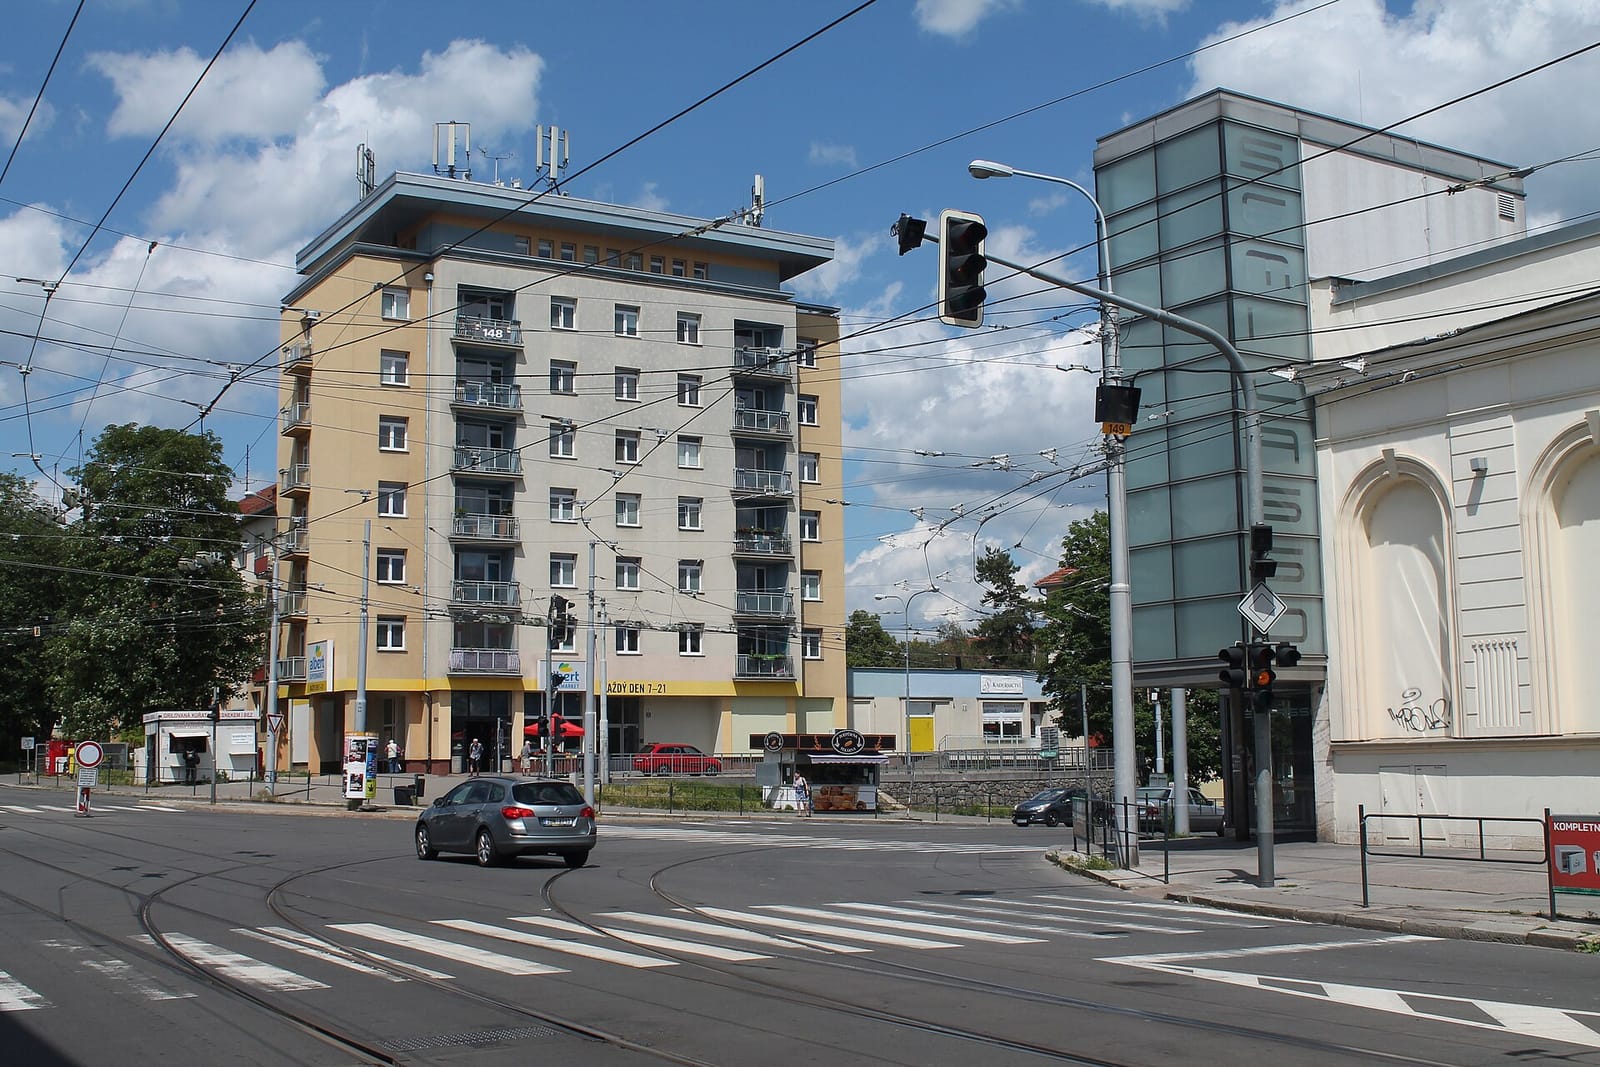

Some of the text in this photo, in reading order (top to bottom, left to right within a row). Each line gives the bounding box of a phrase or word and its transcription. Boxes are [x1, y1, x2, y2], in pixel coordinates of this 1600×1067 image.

[482, 328, 503, 338] 148
[1109, 424, 1125, 434] 149
[607, 681, 626, 694] AŽDÝ
[629, 683, 645, 694] DEN
